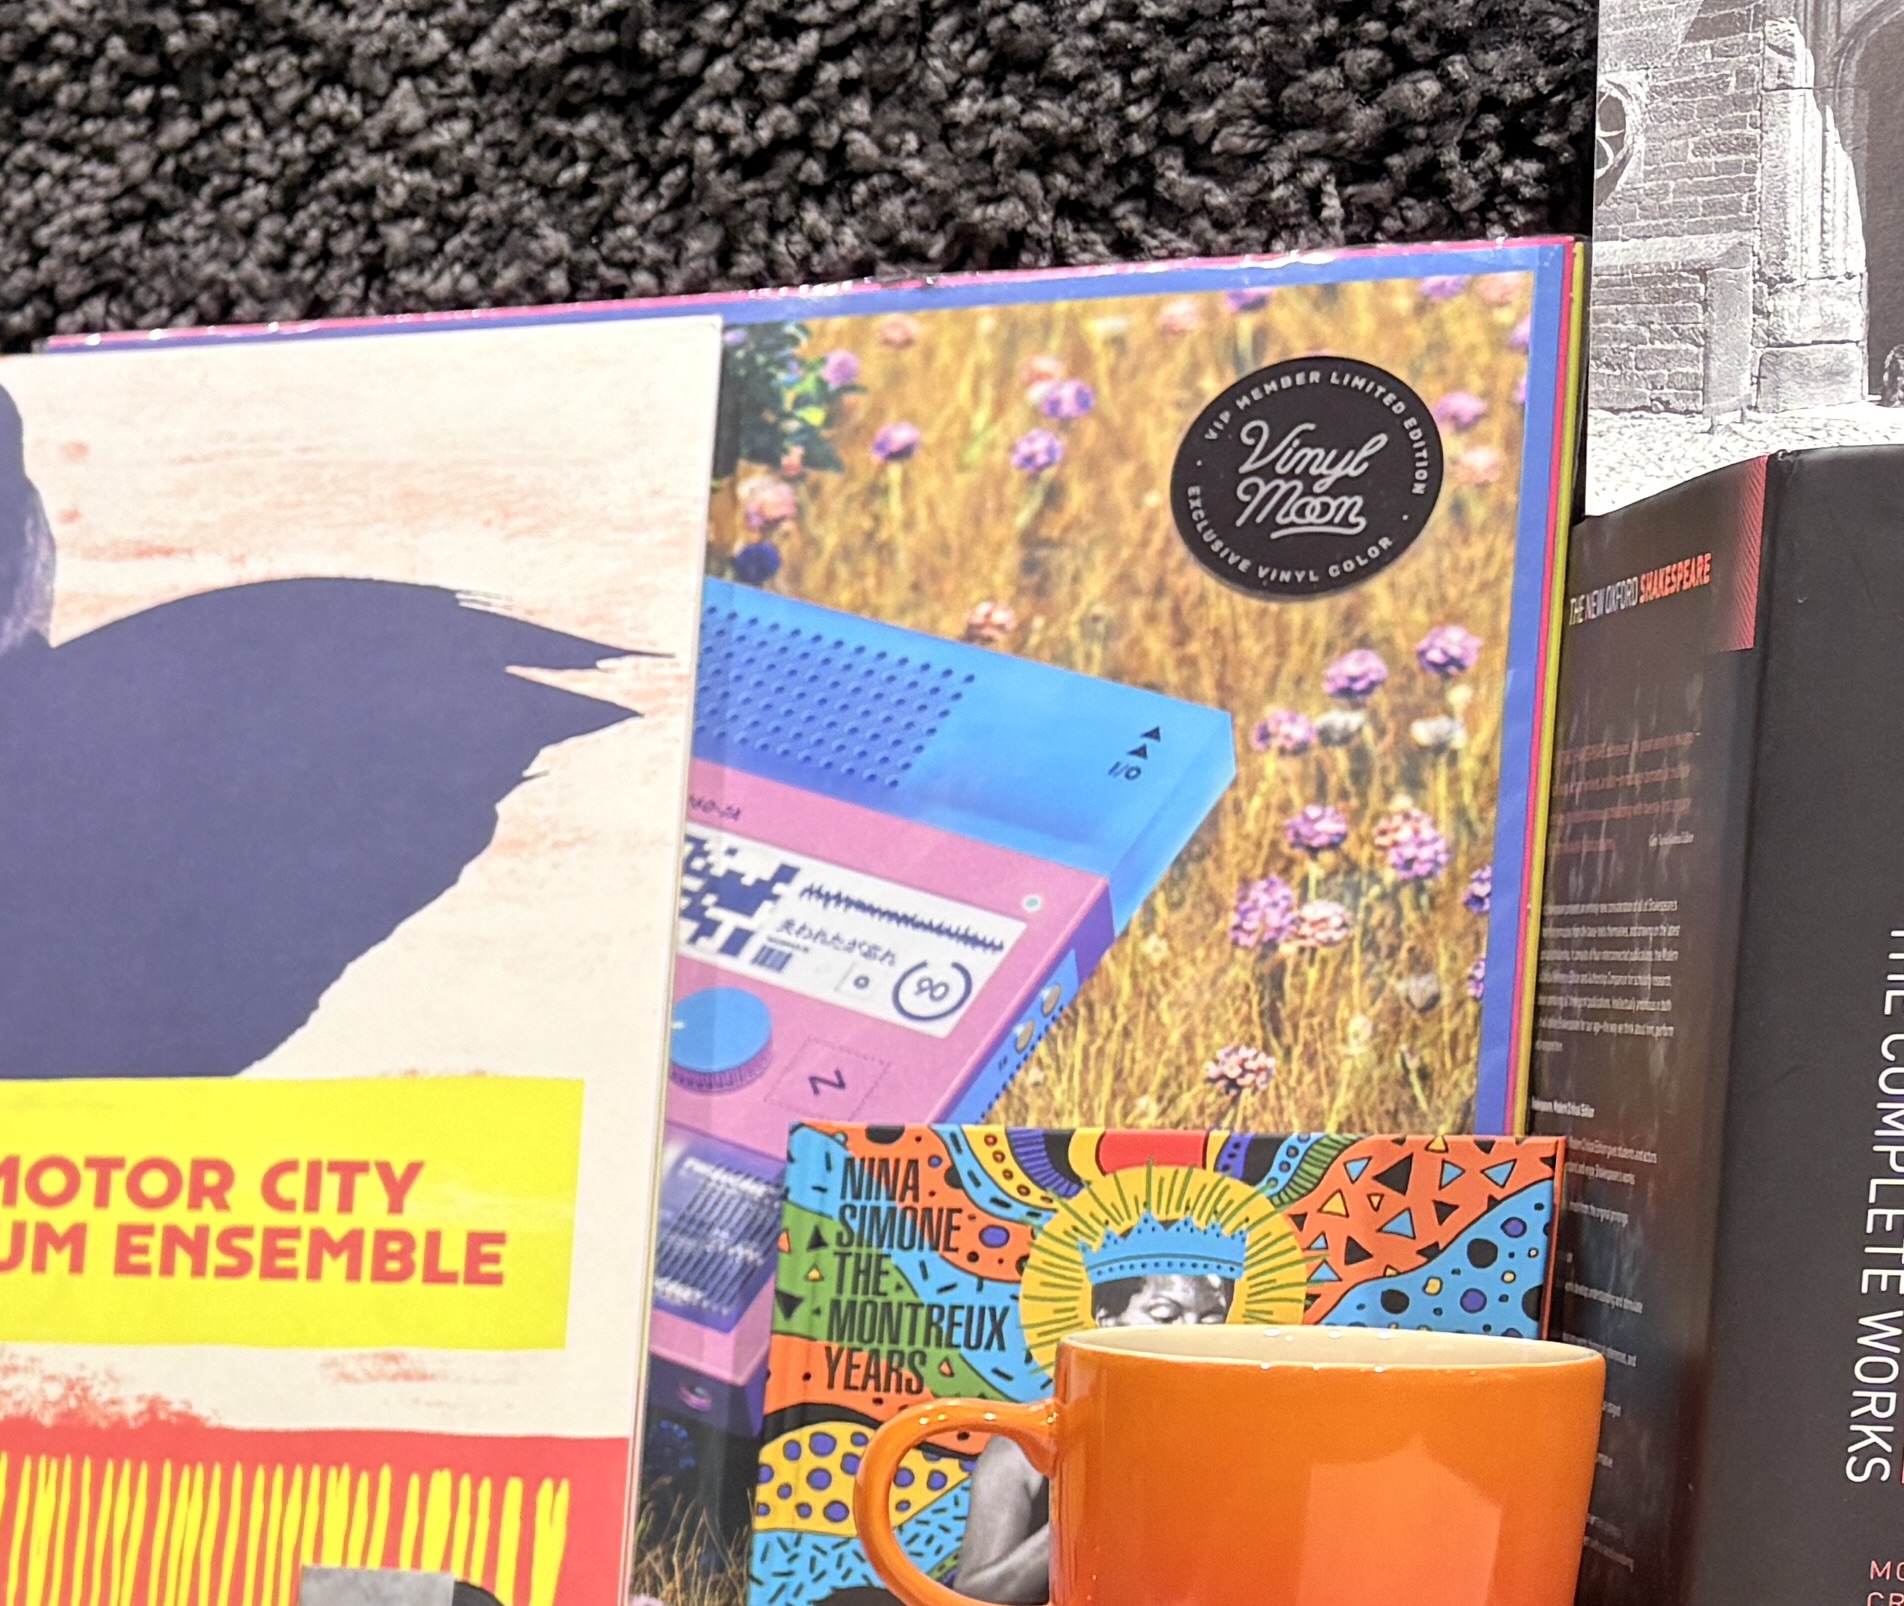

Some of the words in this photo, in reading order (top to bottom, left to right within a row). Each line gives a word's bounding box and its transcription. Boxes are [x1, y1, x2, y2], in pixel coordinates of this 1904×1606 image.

[1204, 410, 1232, 441] VIP
[1235, 370, 1321, 411] MEMBER
[1330, 371, 1407, 416] LIMITED
[1403, 416, 1428, 495] EDITION
[1238, 420, 1388, 493] Vinyl
[1188, 485, 1252, 573] EXCLUSIVE
[1258, 566, 1319, 583] VINYL
[1328, 536, 1393, 578] COLOR
[1236, 477, 1368, 540] Moon
[1569, 594, 1585, 626] THE
[1584, 586, 1606, 622] NEW
[1605, 576, 1639, 614] OXFORD
[1639, 552, 1713, 604] SHAKESPEARE
[261, 1157, 425, 1215] CITY
[839, 1157, 920, 1204] NINA
[113, 1225, 508, 1288] ENSEMBLE
[835, 1204, 964, 1254] SIMONE
[832, 1251, 892, 1298] THE
[826, 1299, 1010, 1352] MONTREUX
[824, 1345, 927, 1396] YEARS
[1844, 1309, 1904, 1484] WORKS
